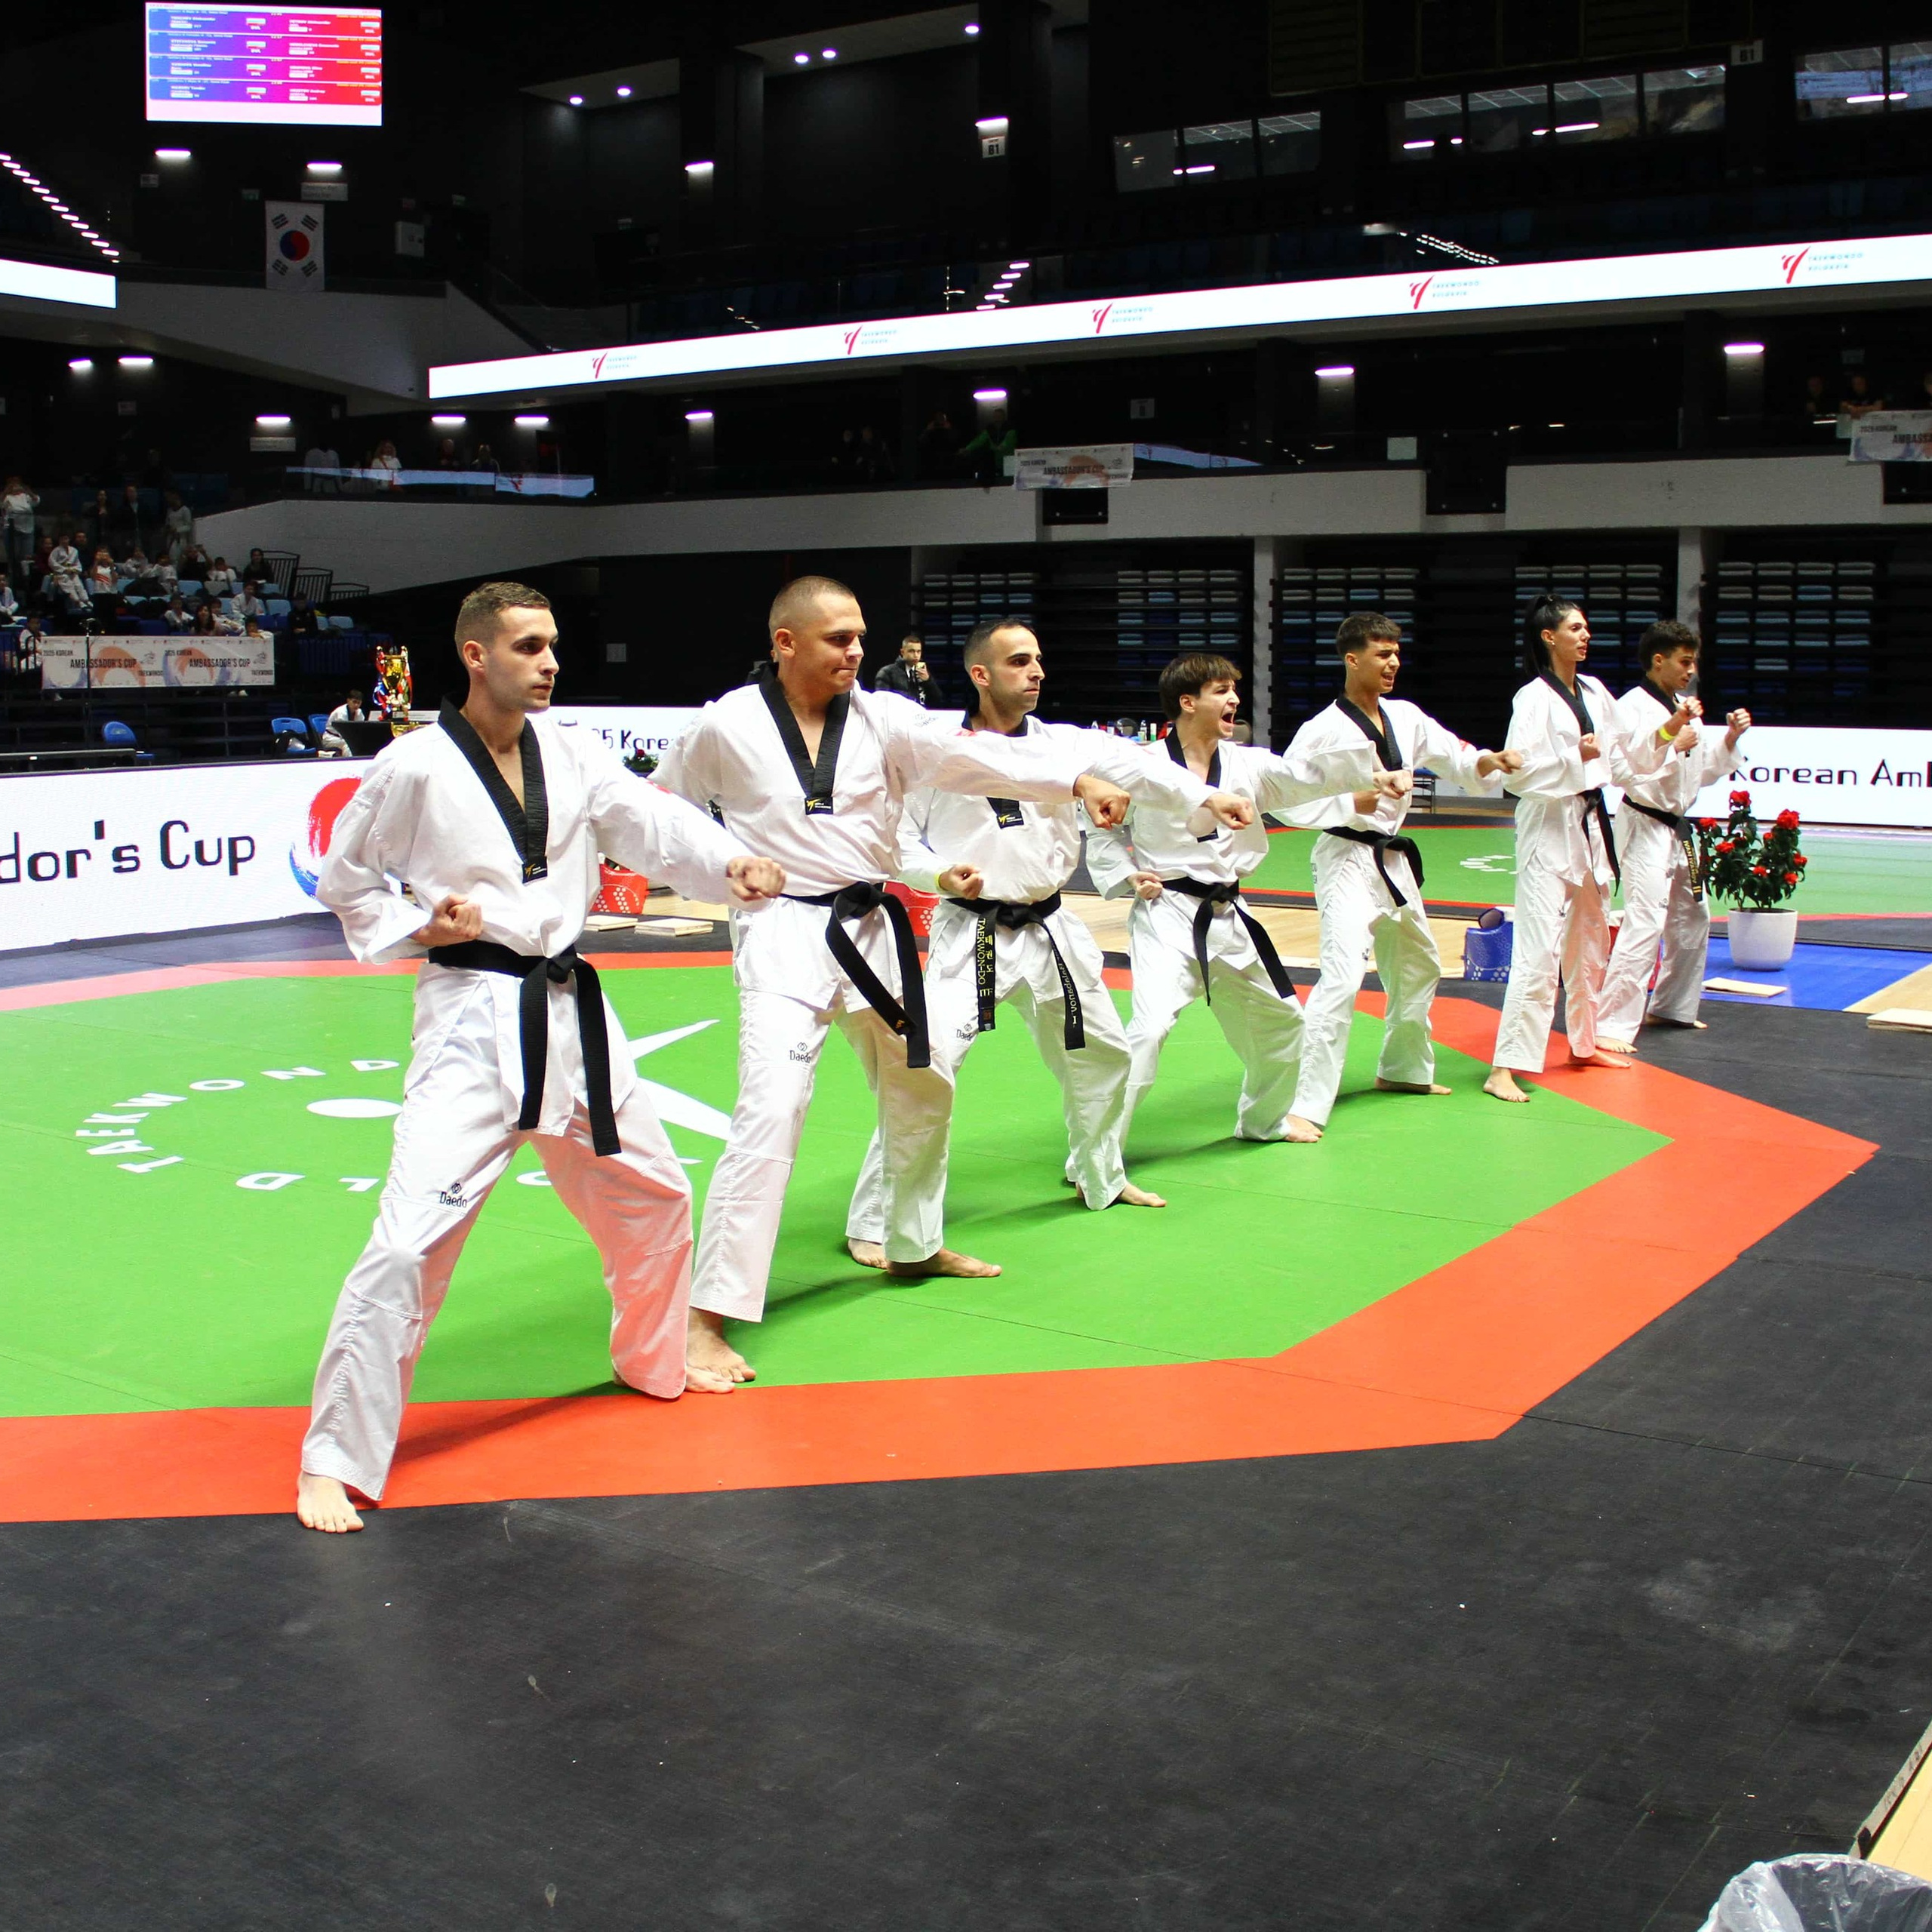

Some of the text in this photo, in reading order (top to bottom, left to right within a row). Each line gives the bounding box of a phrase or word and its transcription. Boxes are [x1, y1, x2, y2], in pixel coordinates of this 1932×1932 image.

[70, 659, 122, 669] AMBSSADOR'S
[189, 658, 251, 668] AMBASSADOR'S CUP
[160, 820, 255, 876] Cup
[977, 918, 986, 985] TAEKWON-DO
[440, 1191, 467, 1208] Daedo
